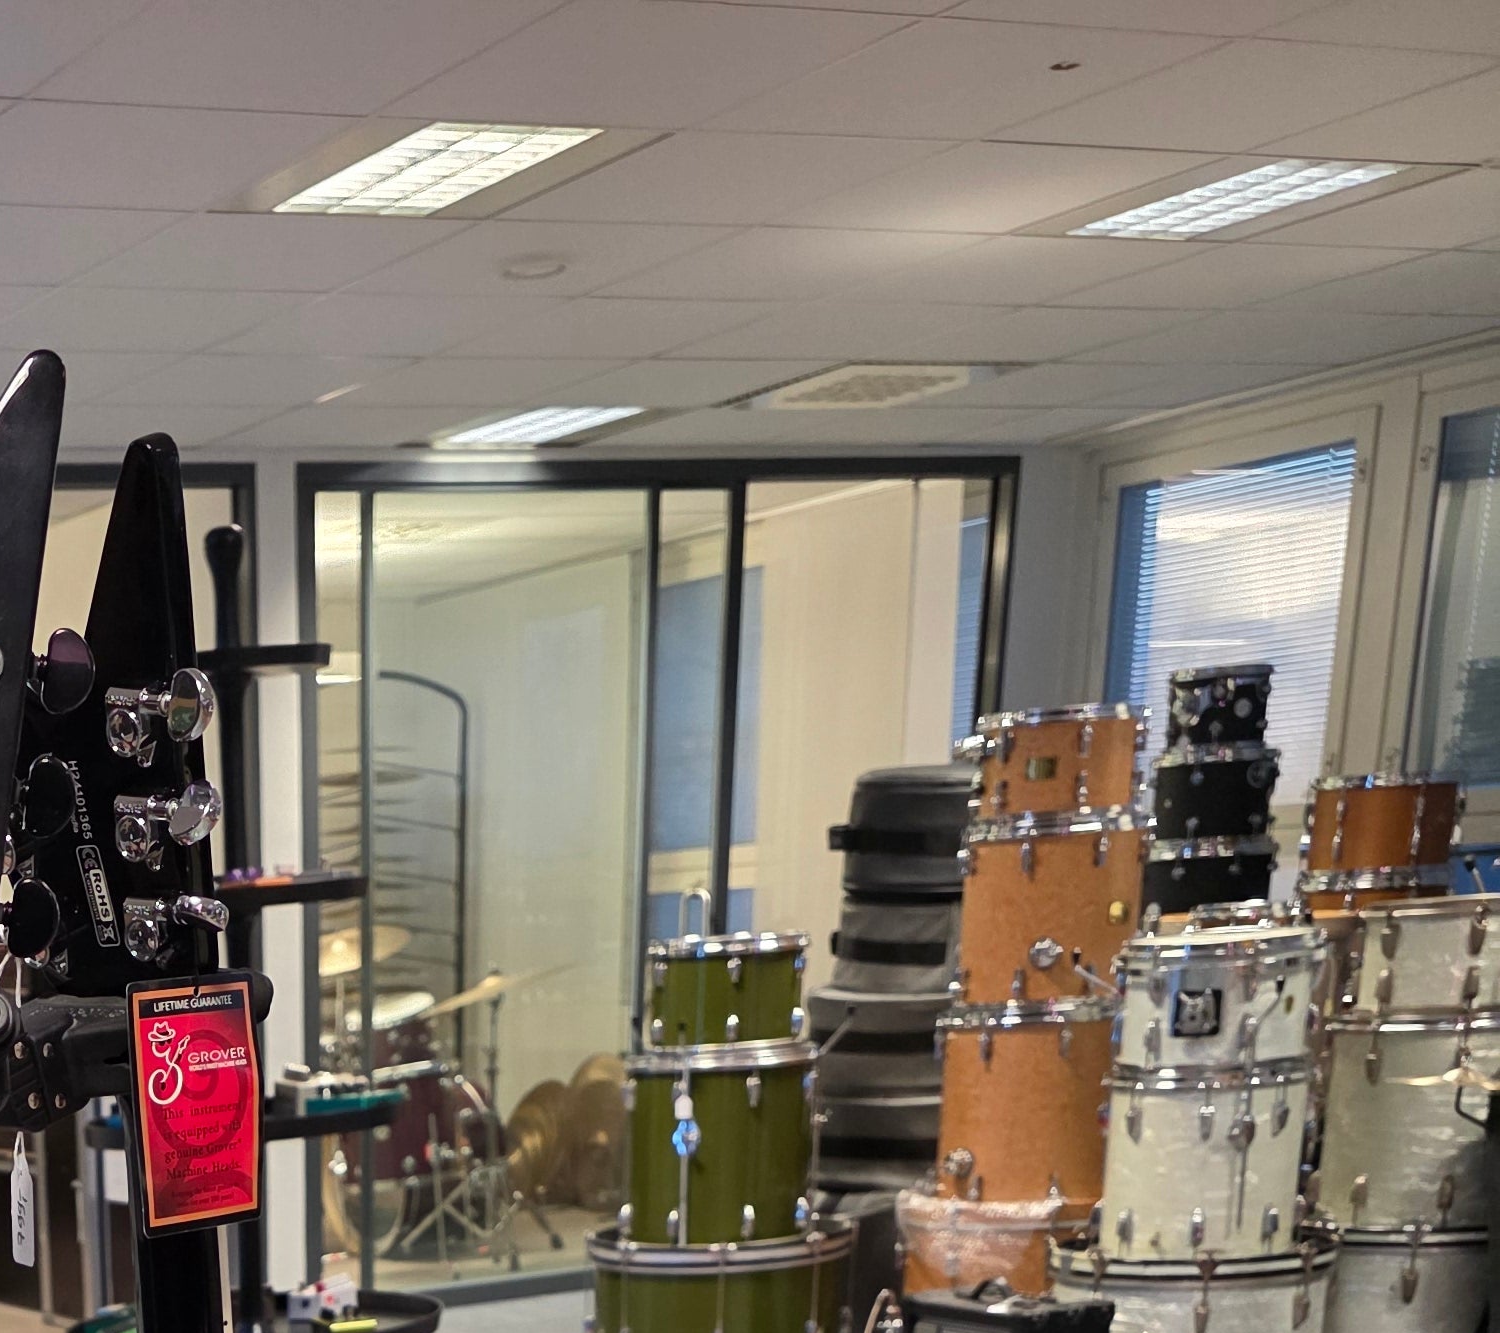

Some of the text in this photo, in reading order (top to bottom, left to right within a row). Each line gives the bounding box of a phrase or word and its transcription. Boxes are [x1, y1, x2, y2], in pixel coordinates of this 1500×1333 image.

[92, 872, 111, 919] RoHS
[153, 994, 233, 1012] LIFETIME GUARANTEE
[187, 1046, 246, 1064] GROVER
[162, 1101, 243, 1120] This instrument
[175, 1121, 219, 1142] equipped
[164, 1146, 203, 1164] genuine
[167, 1165, 209, 1181] Machine
